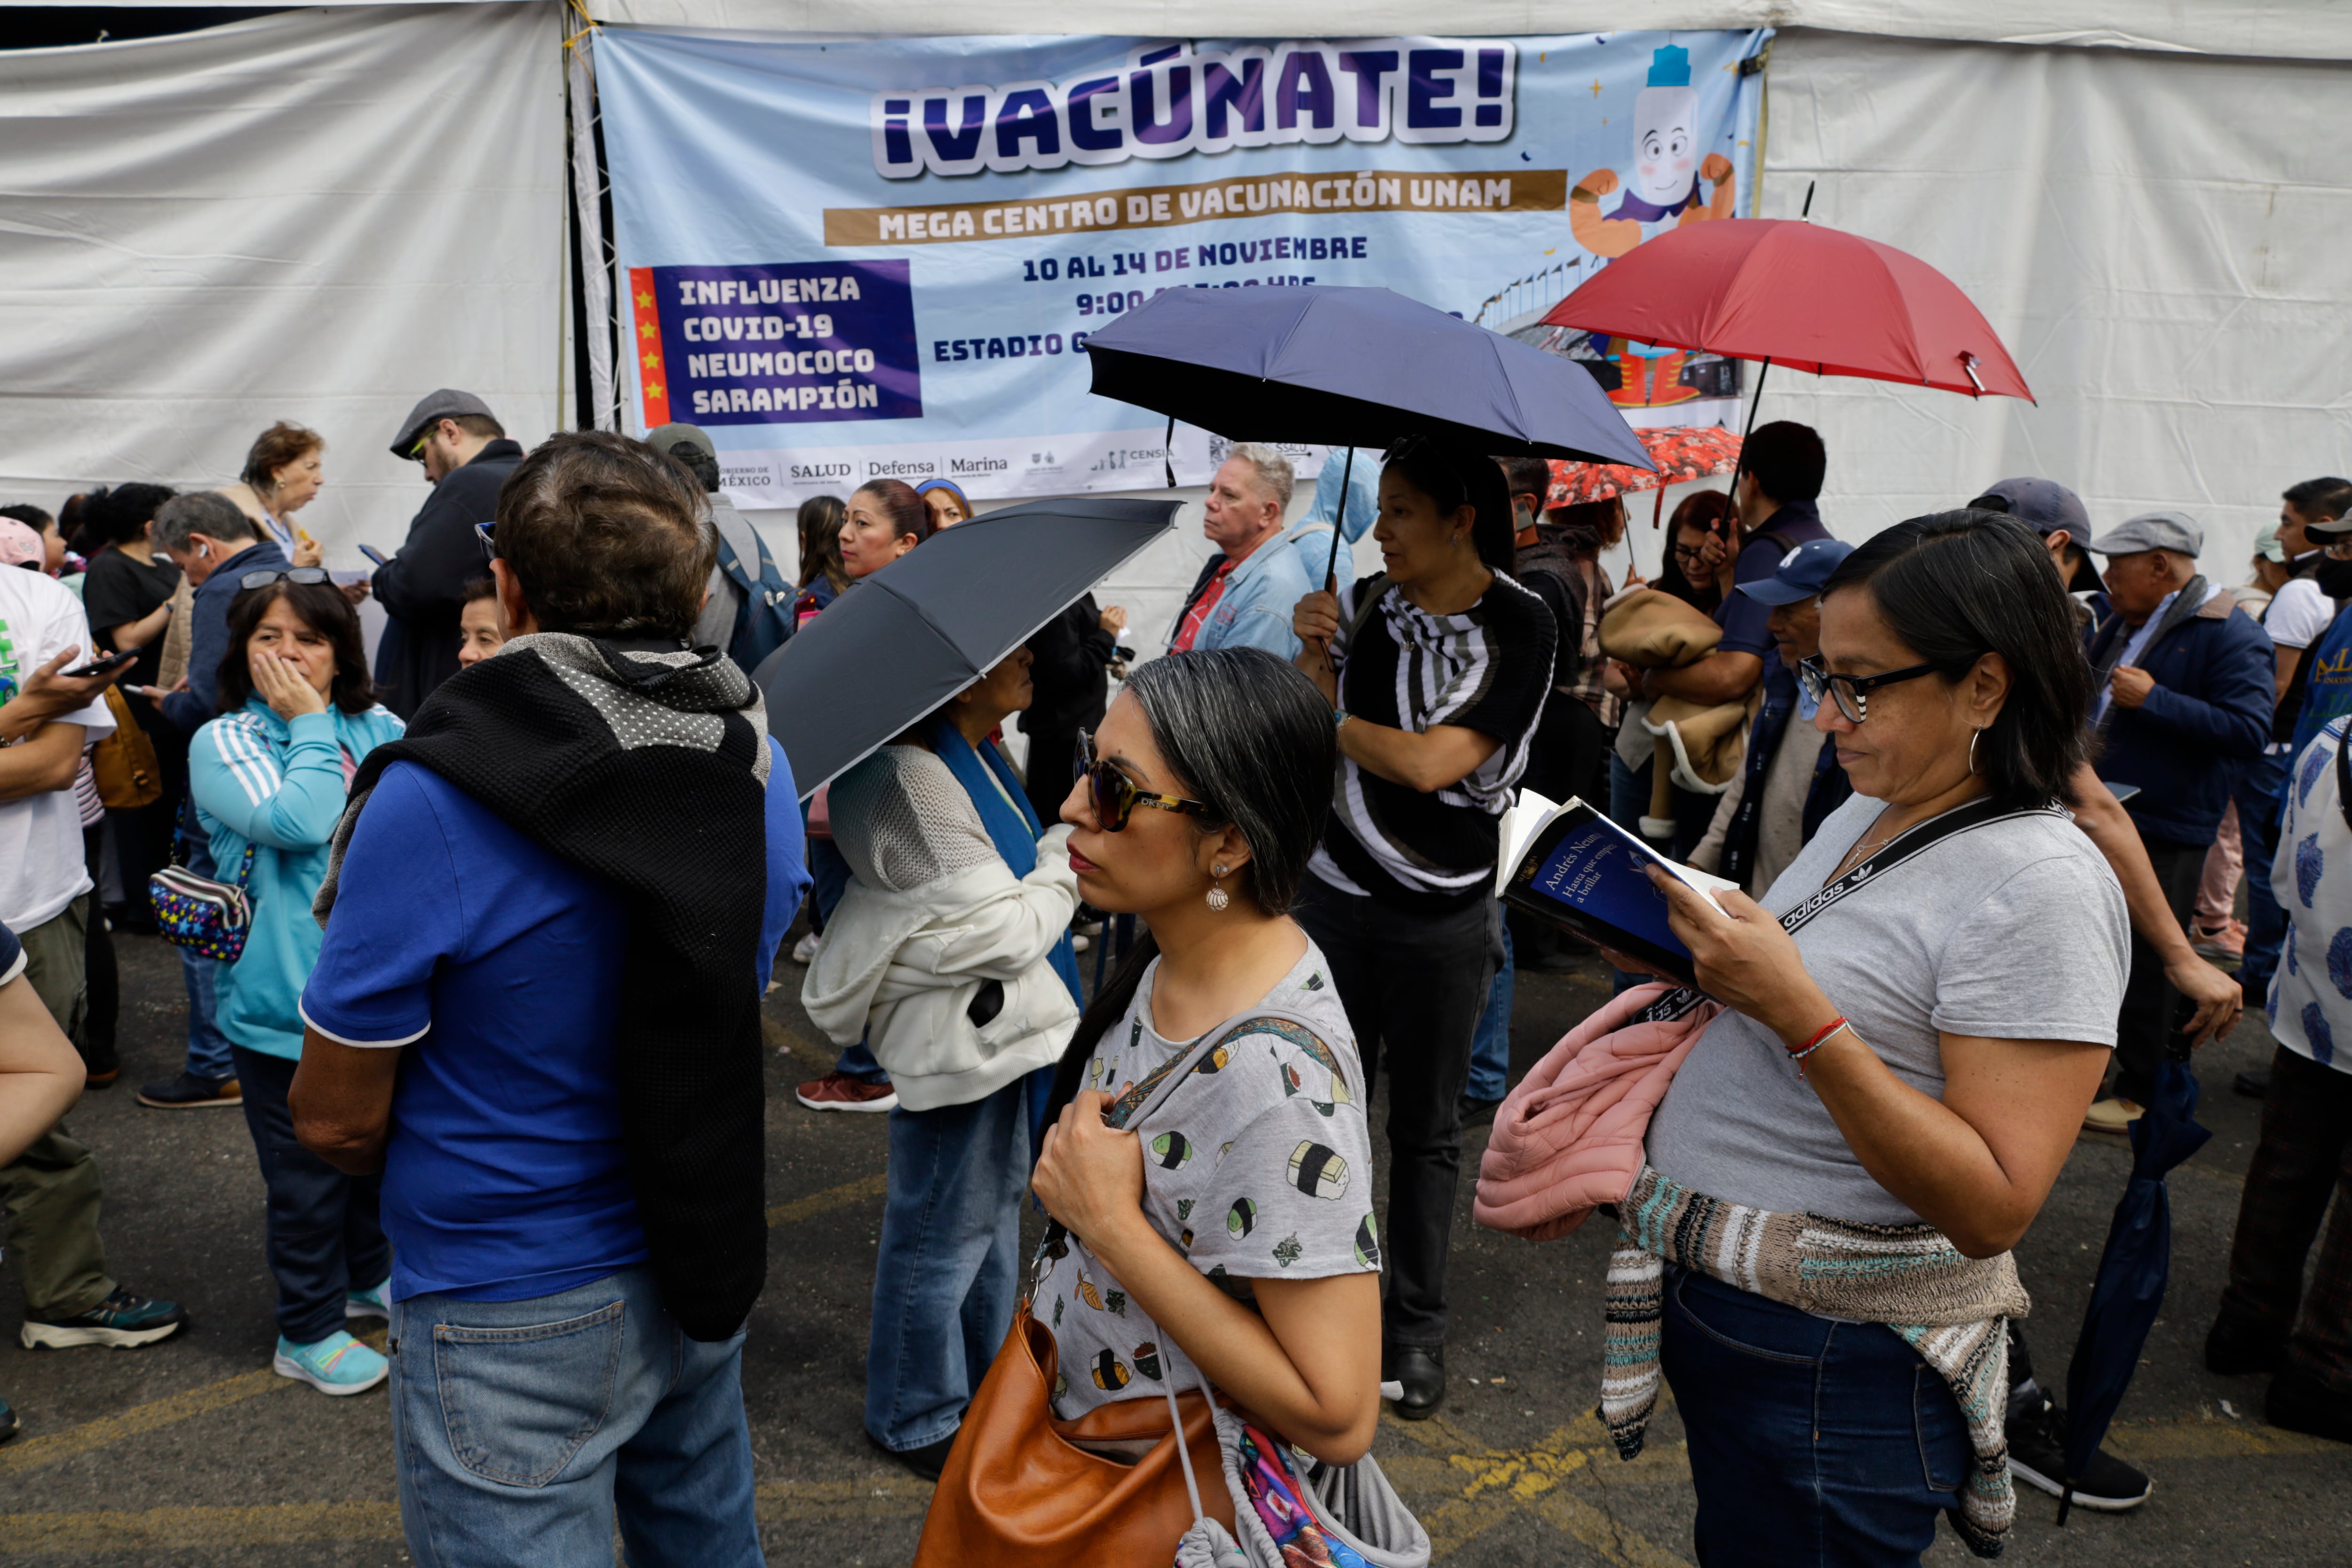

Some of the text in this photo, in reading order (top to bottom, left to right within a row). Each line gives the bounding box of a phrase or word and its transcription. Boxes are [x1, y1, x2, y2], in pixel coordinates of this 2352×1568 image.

[884, 44, 1505, 164] ¡VACÚNATE!
[879, 170, 1510, 240] MEGA CENTRO DE VACUNACIÓN UNAM
[1024, 236, 1367, 281] 10 AL 14 DE NOVIEMBRE
[679, 276, 860, 305] INFLUENZA
[683, 314, 833, 342] COVID-19
[934, 334, 1063, 362] ESTADIO
[688, 349, 874, 378] NEUMOCOCO
[692, 378, 878, 414] SARAMPIÓN
[790, 463, 851, 478] SALUD
[869, 461, 934, 476] Defensa
[950, 457, 1008, 472] Marina
[1141, 797, 1172, 810] DKNY
[1546, 853, 1577, 891] Andrés
[1562, 873, 1585, 898] Hasta
[1583, 859, 1597, 873] que
[1577, 871, 1602, 896] brillar
[1784, 882, 1844, 927] adidas
